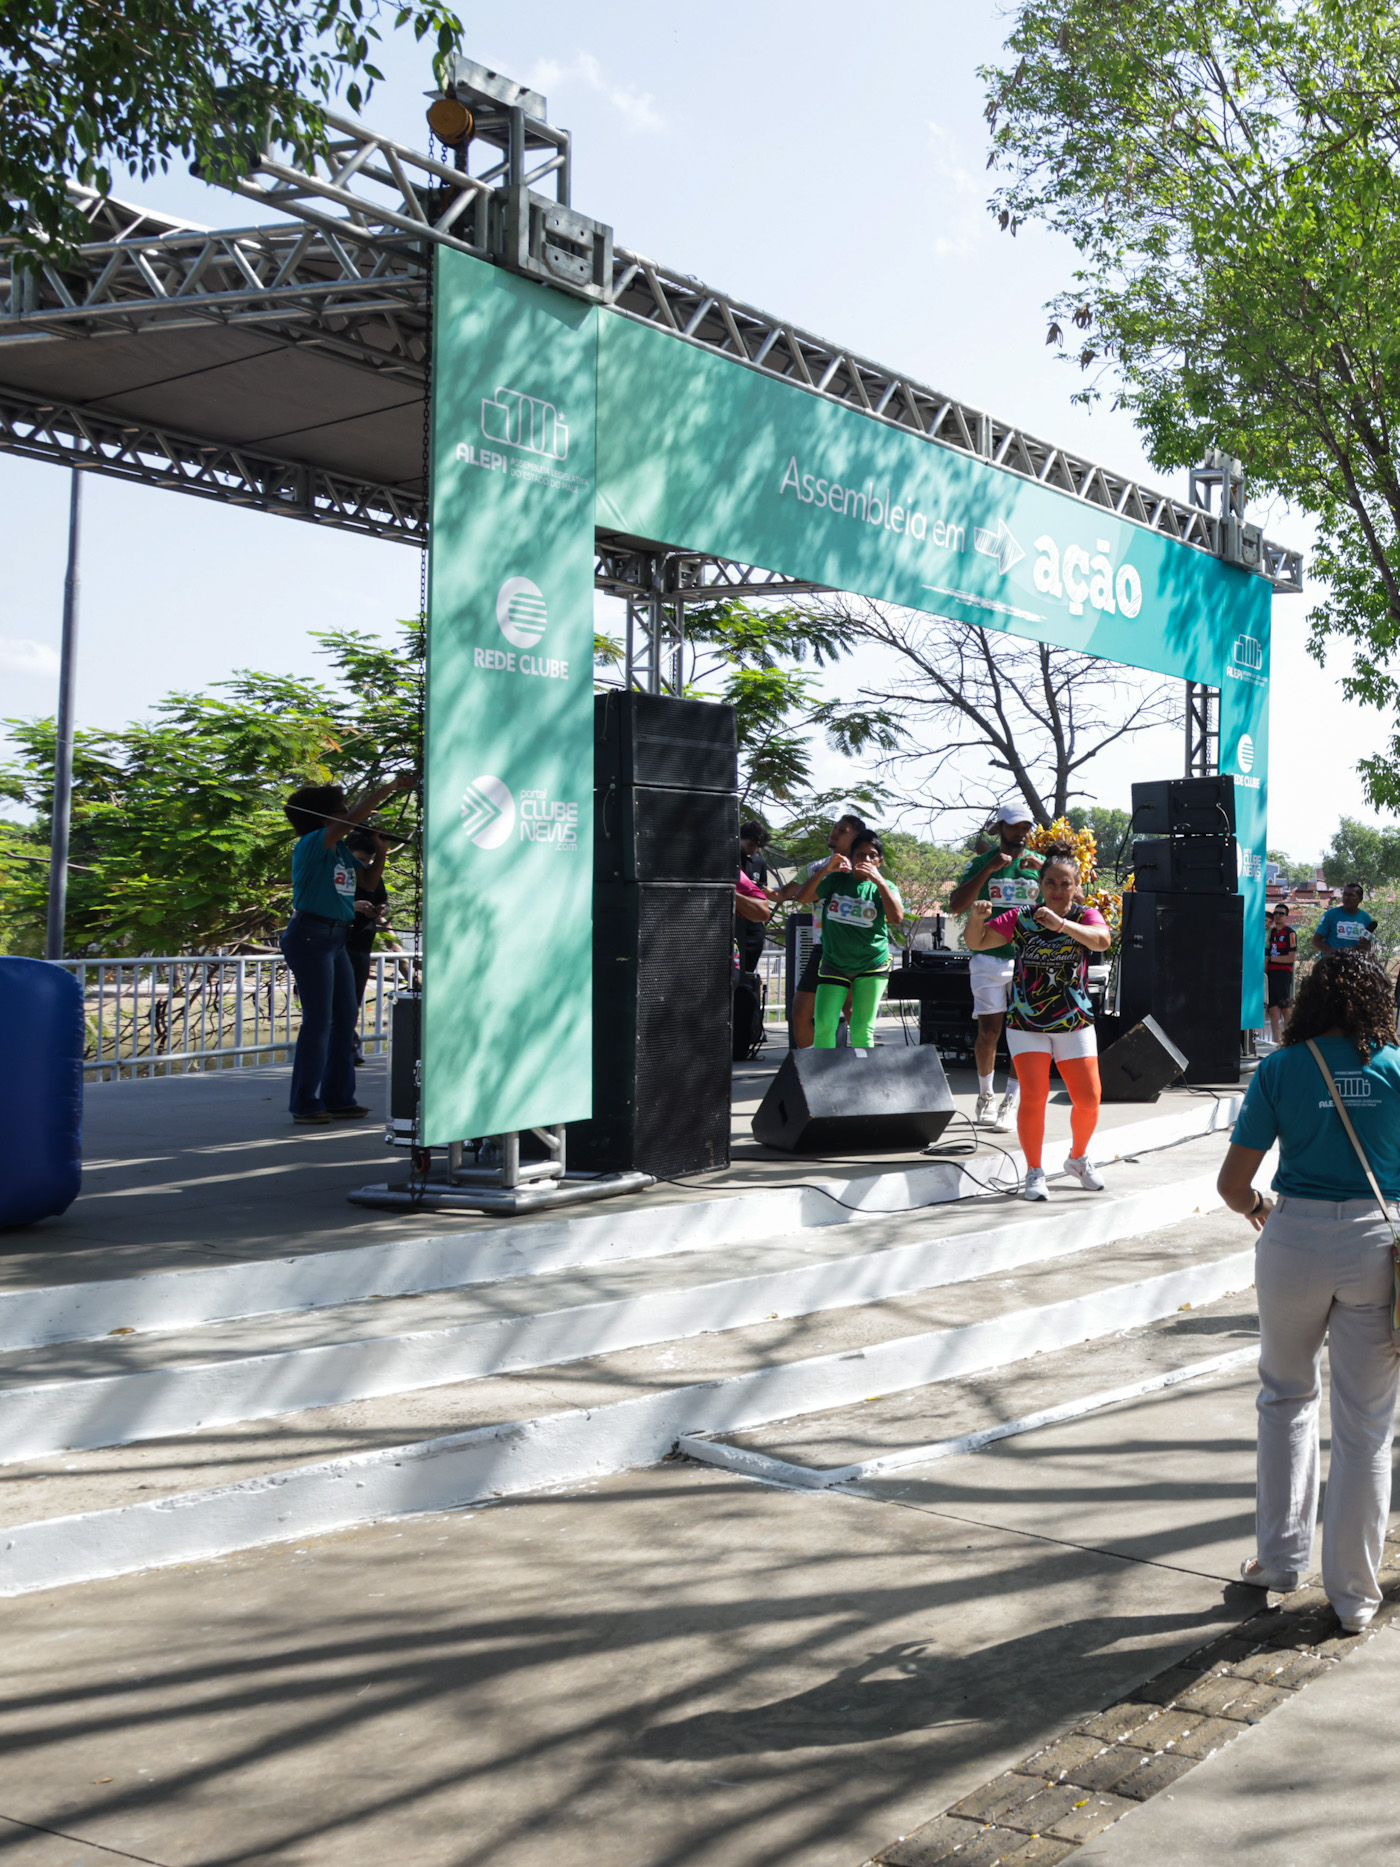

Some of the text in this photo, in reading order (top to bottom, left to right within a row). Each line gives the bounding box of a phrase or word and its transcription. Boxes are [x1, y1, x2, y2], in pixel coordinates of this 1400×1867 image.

[456, 442, 508, 474] ALEPI
[510, 457, 590, 486] ASSEMBLEIA LEGISLATIVA
[510, 468, 522, 478] DO
[522, 471, 549, 485] ESTADO
[550, 479, 561, 489] DO
[779, 455, 966, 553] Assembleia em
[1033, 534, 1143, 619] ação
[474, 647, 569, 680] REDE CLUBE
[1232, 774, 1261, 789] EDE CLUBE
[520, 788, 547, 800] portal
[520, 800, 578, 822] CLUBE
[520, 820, 578, 843] NEWS
[555, 843, 578, 851] .com
[1243, 854, 1262, 866] CLUBE
[1243, 865, 1262, 878] NEWS
